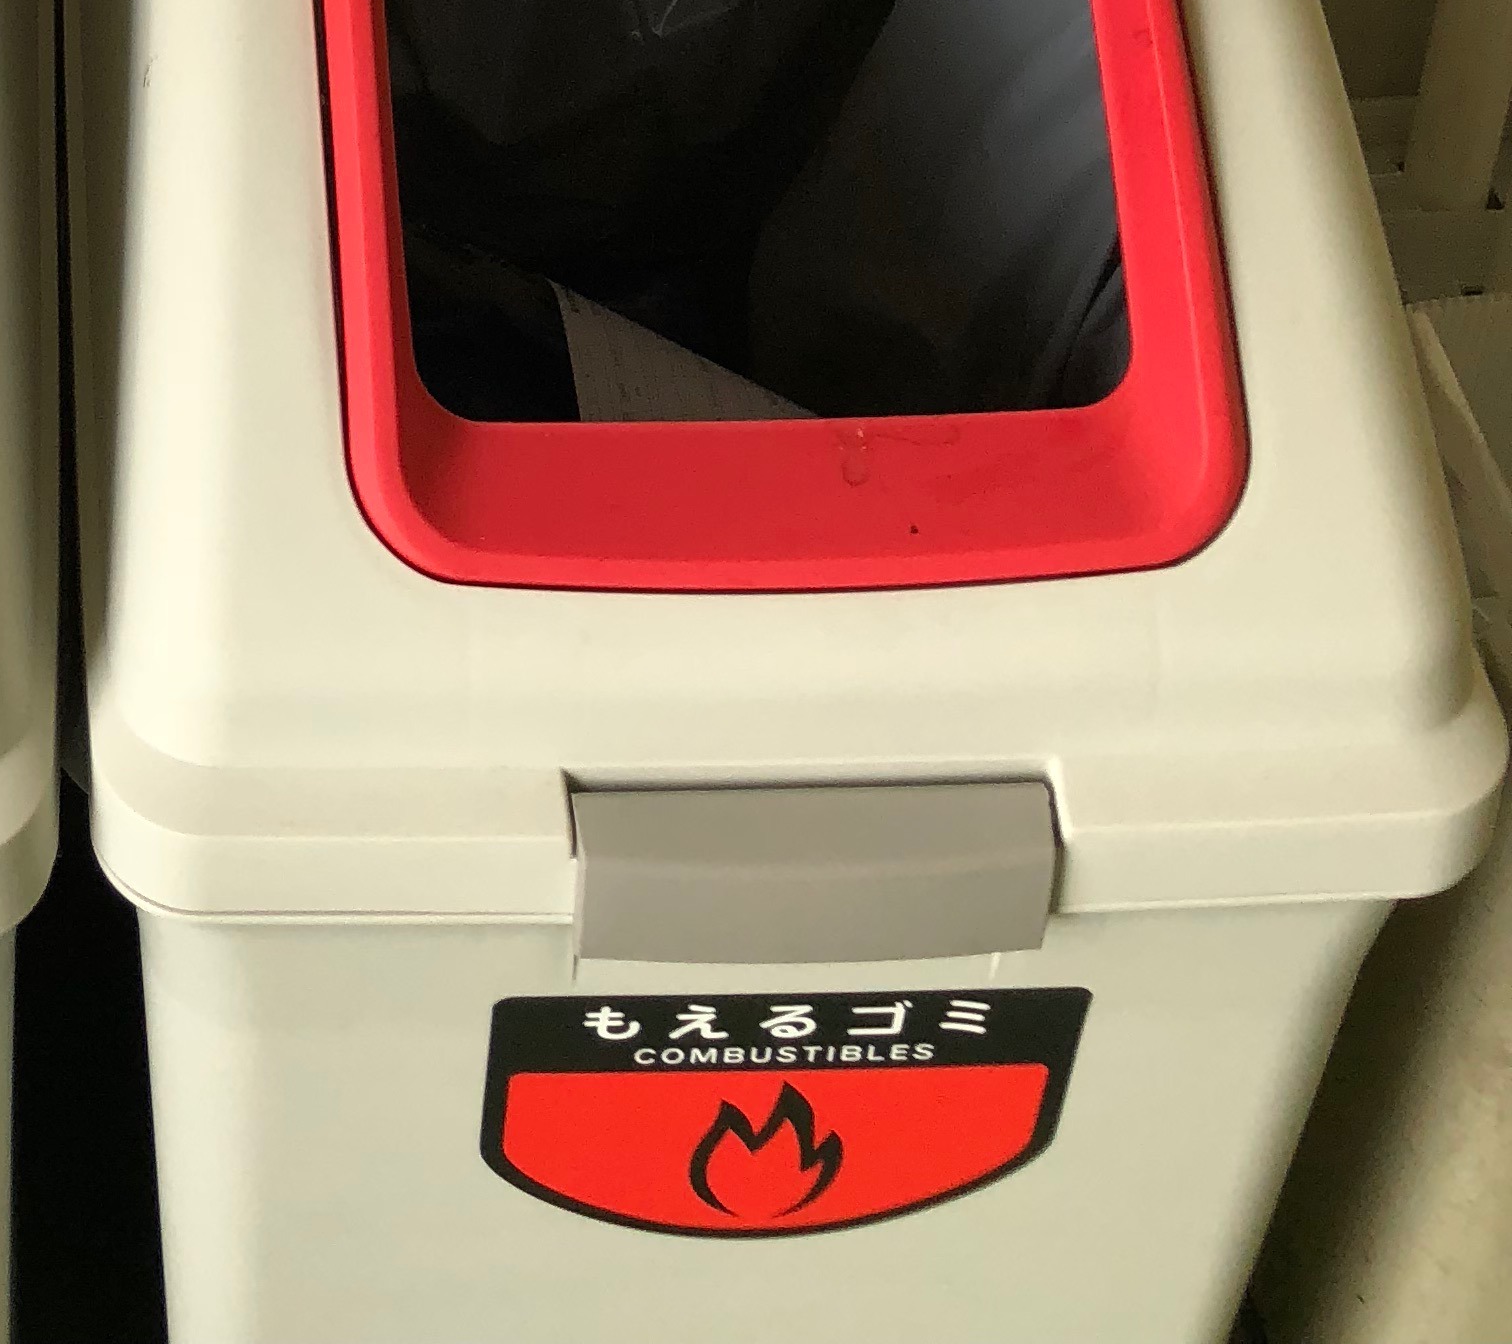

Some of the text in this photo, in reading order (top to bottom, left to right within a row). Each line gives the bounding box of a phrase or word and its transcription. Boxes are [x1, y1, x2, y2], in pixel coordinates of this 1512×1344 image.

[584, 998, 992, 1041] もえるゴミ
[634, 1043, 936, 1066] COMBUSTIBLES
